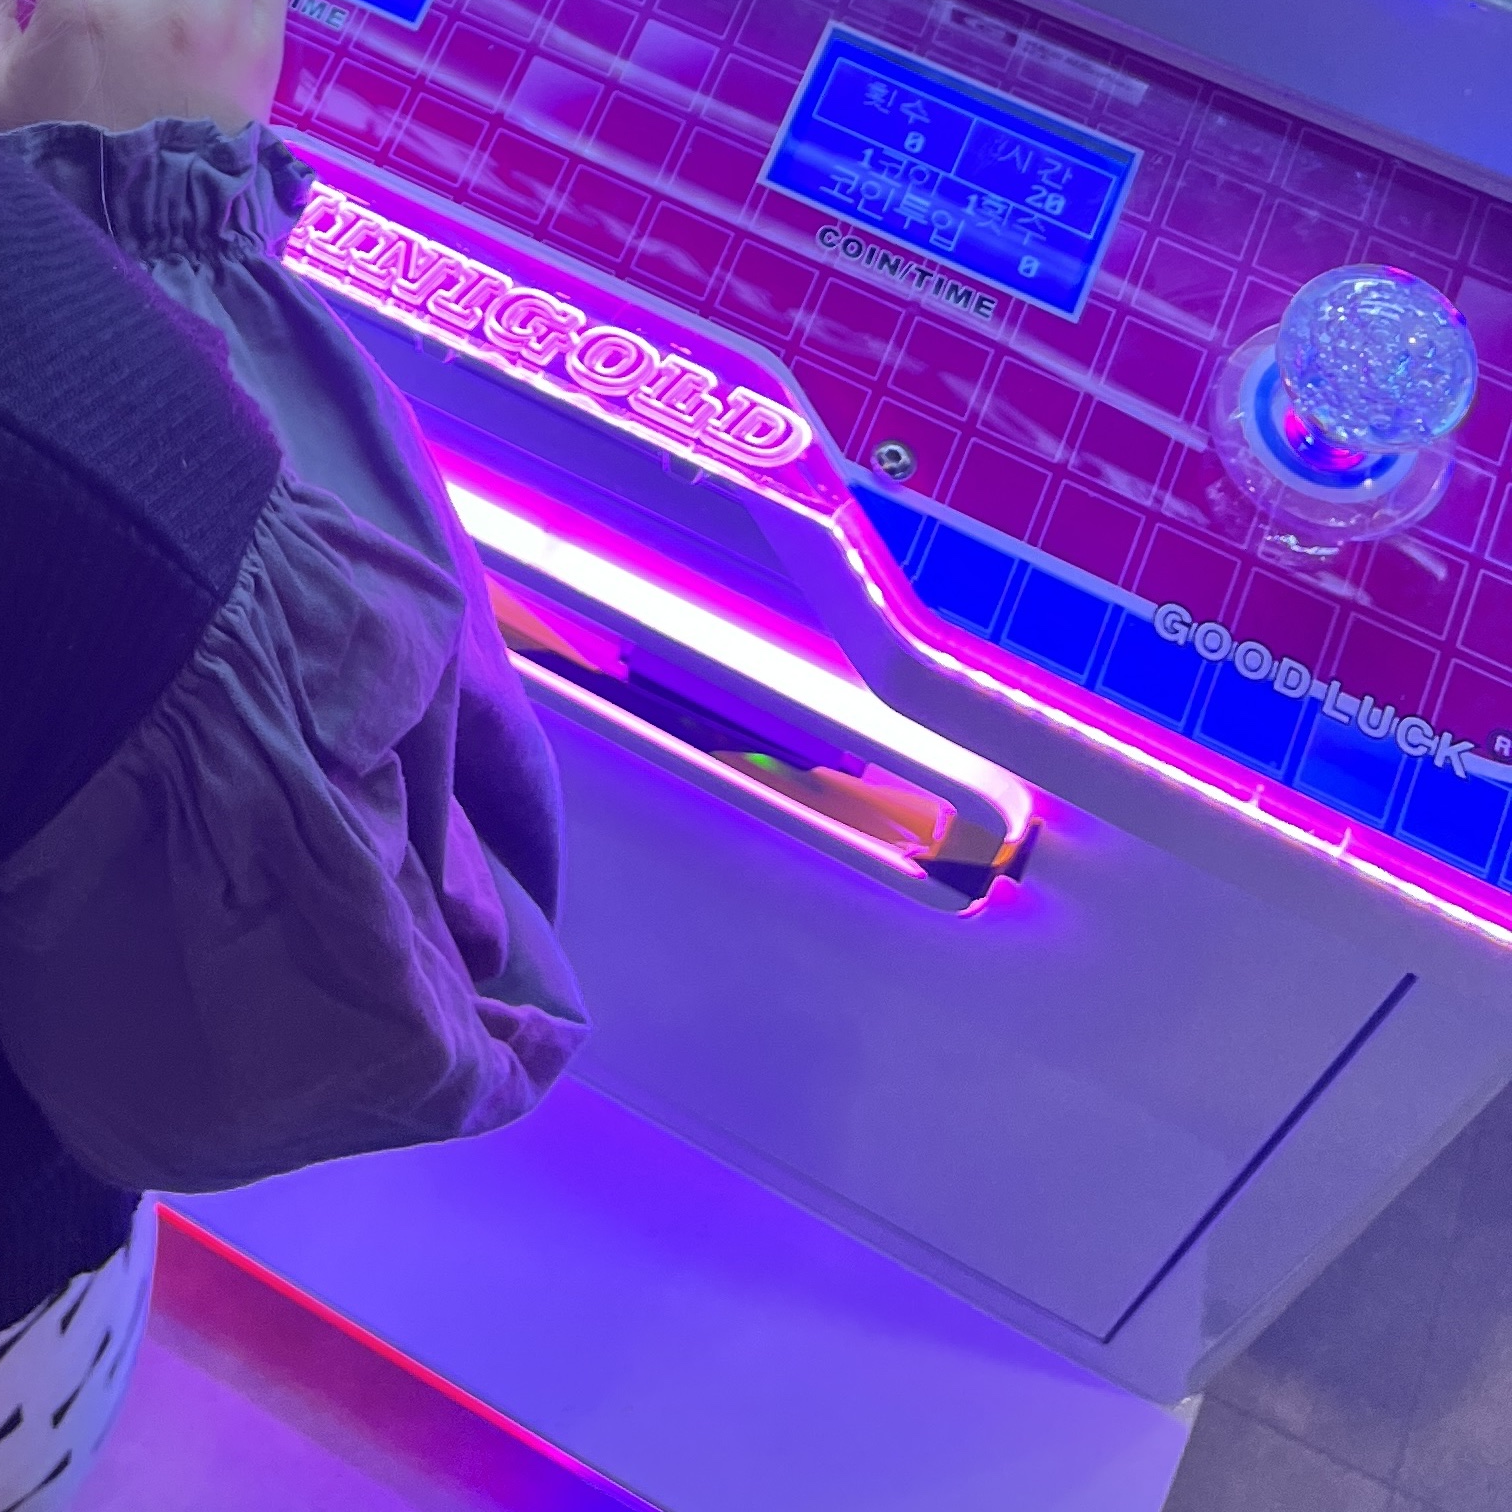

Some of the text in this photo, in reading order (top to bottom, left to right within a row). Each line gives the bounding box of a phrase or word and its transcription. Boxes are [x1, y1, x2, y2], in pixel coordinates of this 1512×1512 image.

[903, 131, 1067, 216] 0 20
[999, 144, 1072, 190] 시간
[818, 165, 1039, 279] 코인투입 0
[817, 225, 996, 319] COIN/TIME
[1153, 602, 1476, 780] GOOD LUCK
